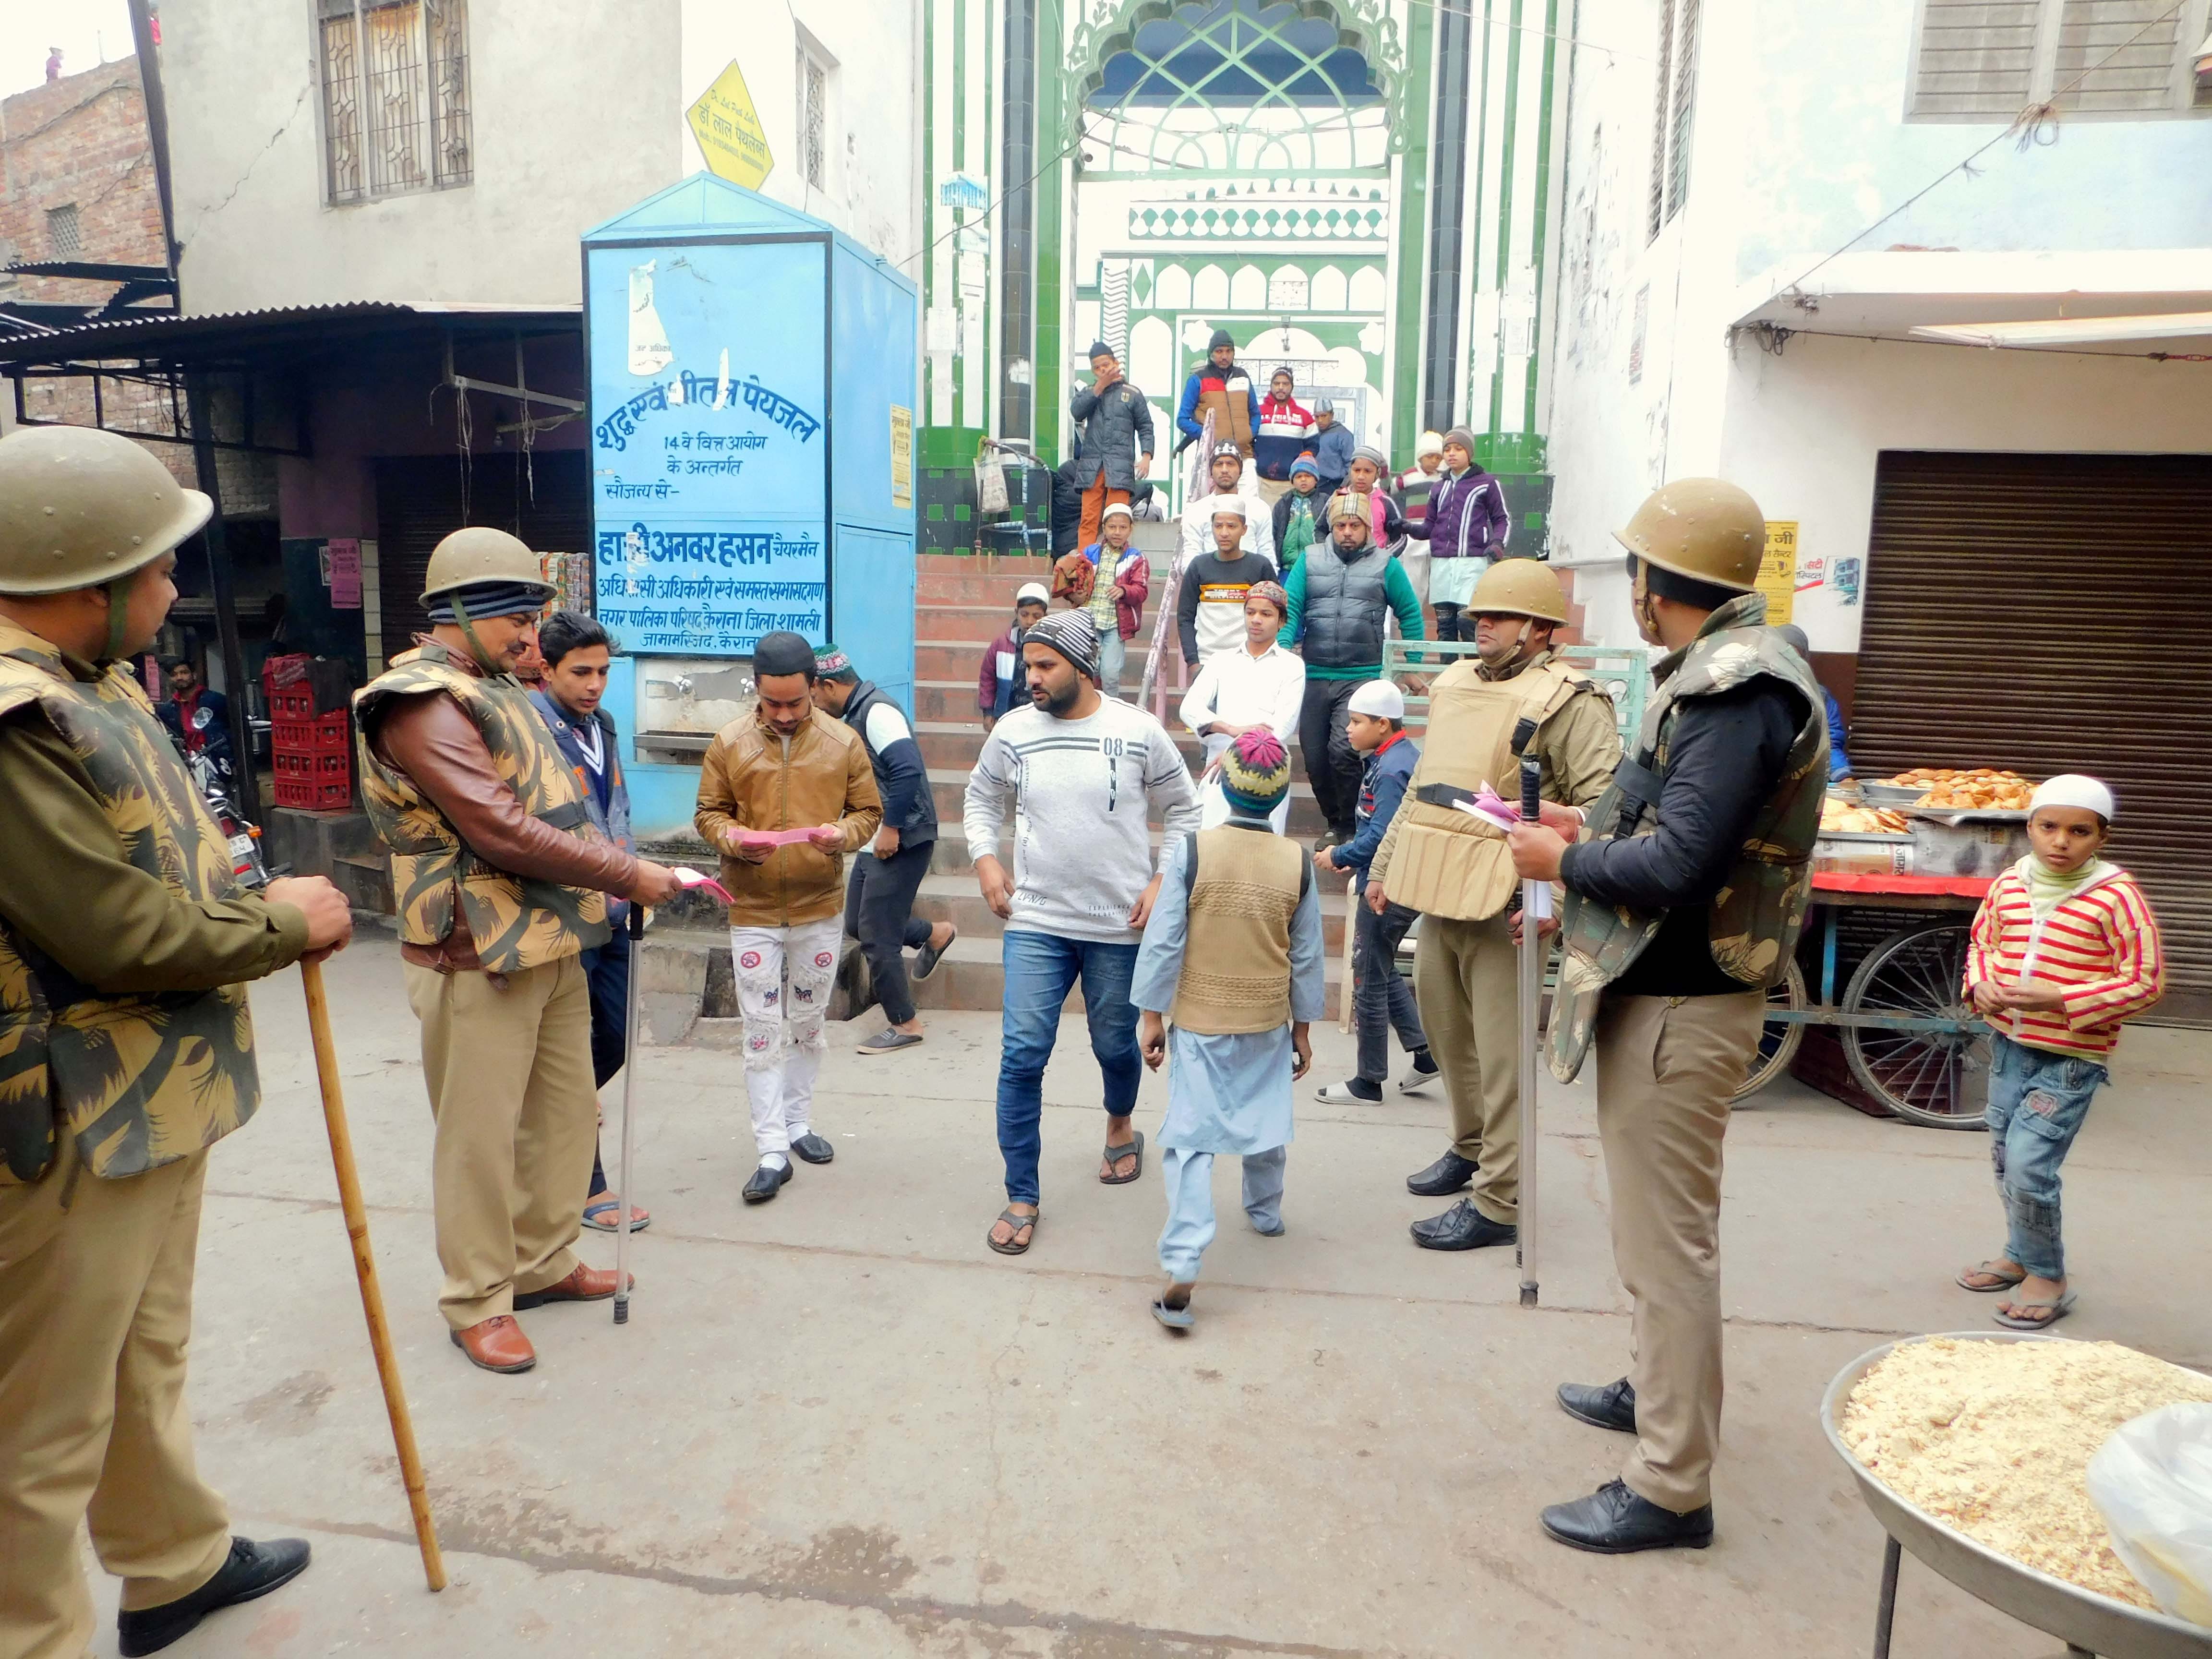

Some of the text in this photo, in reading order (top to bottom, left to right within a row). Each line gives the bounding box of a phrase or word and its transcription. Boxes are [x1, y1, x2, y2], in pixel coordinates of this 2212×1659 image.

[712, 113, 732, 140] लाल
[667, 369, 741, 409] ीतल
[743, 374, 821, 444] पेयजल
[696, 431, 726, 452] वित्त
[726, 431, 769, 450] आयोग
[666, 455, 743, 477] के अन्तर्गत
[604, 476, 652, 499] सौजन्य
[598, 522, 650, 565] हाी
[718, 533, 774, 567] हसन
[655, 575, 714, 600] अधिकारी
[733, 581, 771, 602] समस्त
[600, 609, 627, 627] नगर
[628, 606, 668, 628] पालिका
[702, 602, 744, 630] कैराना
[745, 608, 777, 632] जिला
[777, 608, 821, 632] शामली
[718, 631, 760, 649] कैरान
[1104, 736, 1123, 757] 08
[1895, 848, 1906, 876] जागर
